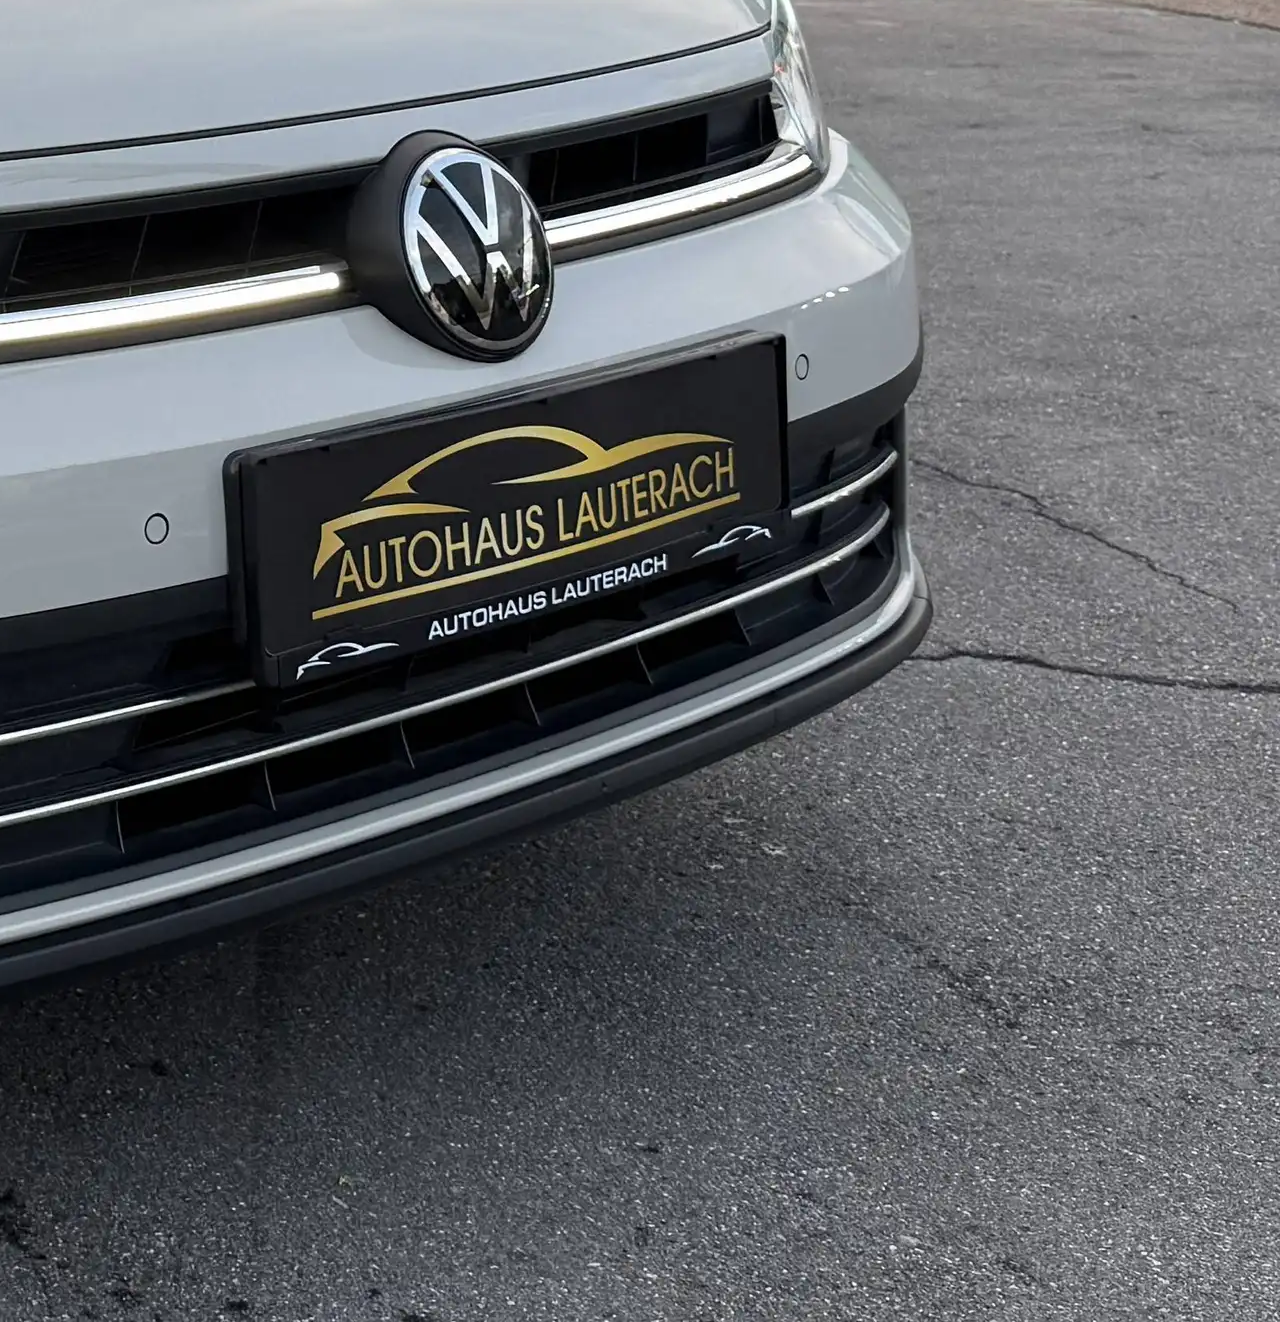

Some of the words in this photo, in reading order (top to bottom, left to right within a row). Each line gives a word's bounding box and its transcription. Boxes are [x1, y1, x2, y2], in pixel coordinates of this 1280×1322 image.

[335, 504, 544, 598] AUTOHAUS
[558, 447, 734, 542] LAUTERACH
[428, 591, 547, 641] AUTOHAUS
[551, 553, 668, 604] LAUTERACH
